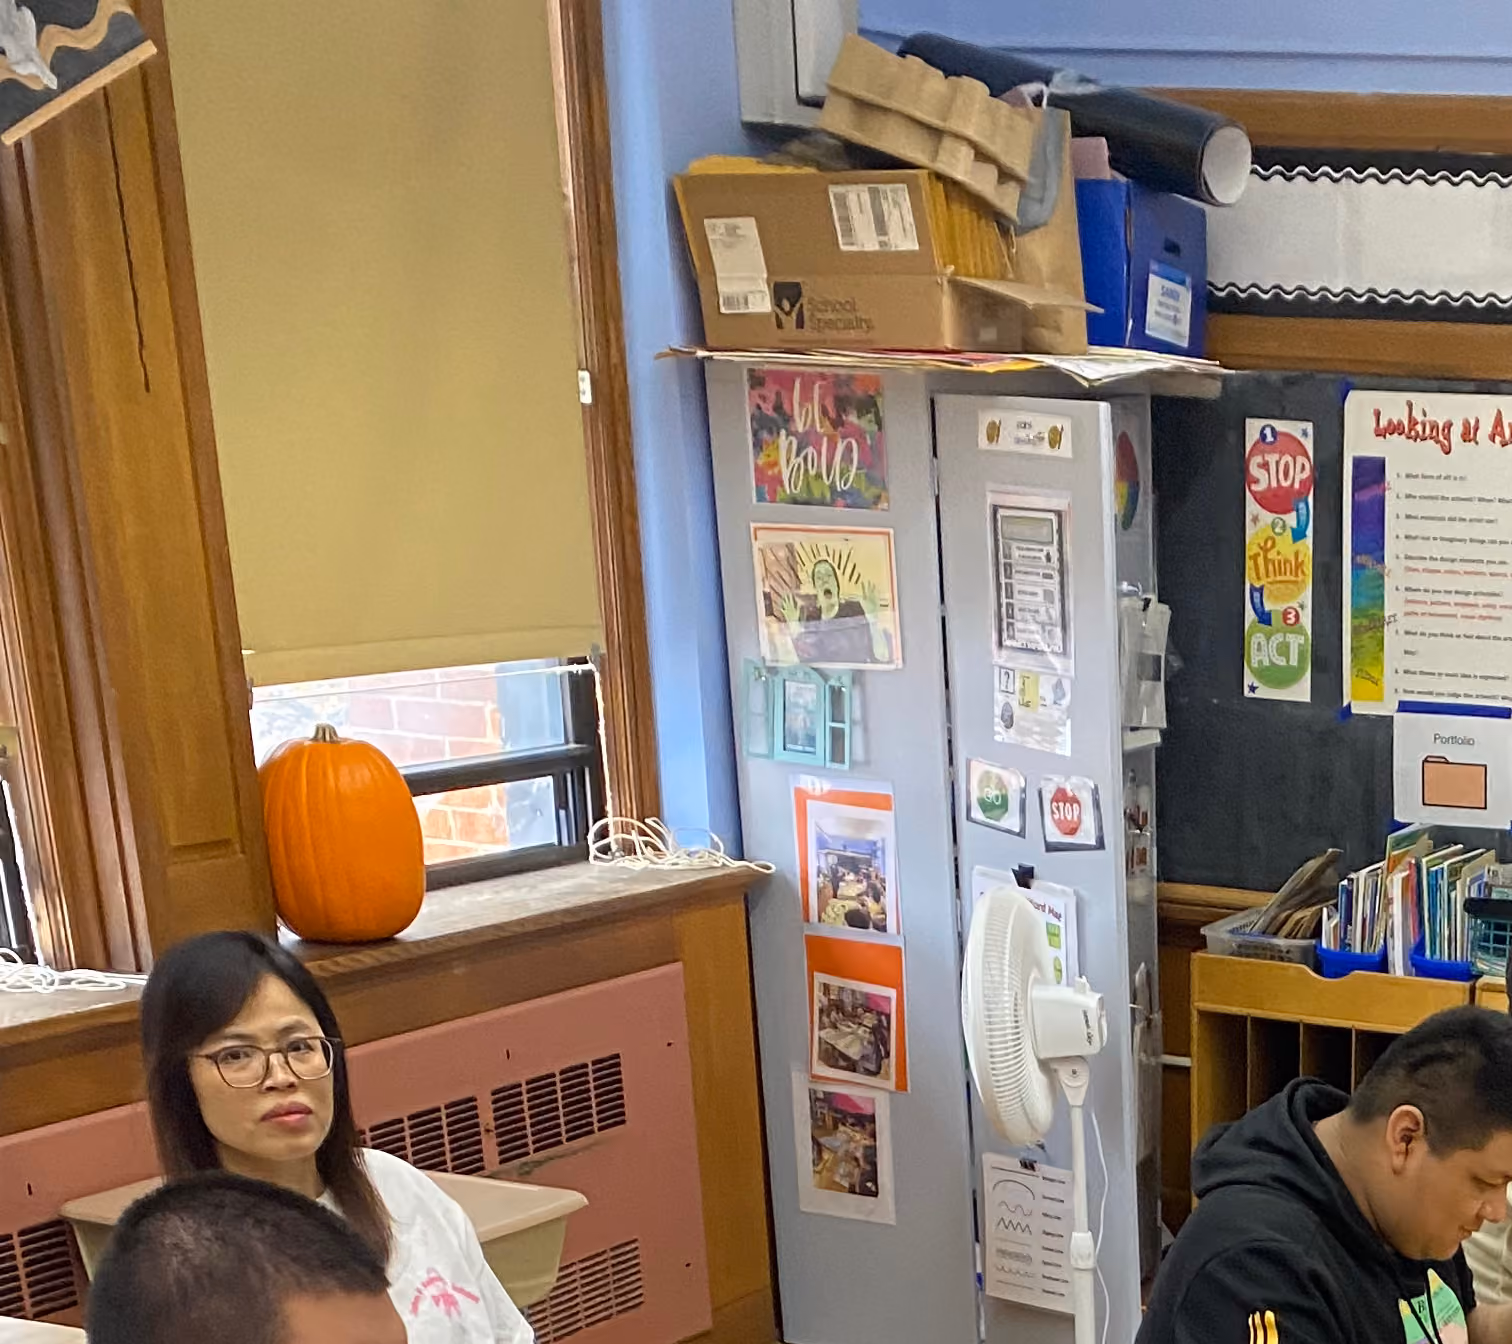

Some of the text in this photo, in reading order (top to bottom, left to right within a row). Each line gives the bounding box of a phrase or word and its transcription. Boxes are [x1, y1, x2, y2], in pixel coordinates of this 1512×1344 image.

[1265, 427, 1275, 441] 1
[1373, 400, 1453, 455] Looking
[1461, 417, 1480, 445] at
[1250, 453, 1311, 493] STOP
[1250, 537, 1307, 582] Think
[1285, 608, 1296, 625] 3
[1251, 633, 1305, 668] ACT
[1433, 732, 1476, 746] Portfolio
[1051, 801, 1080, 821] STOP
